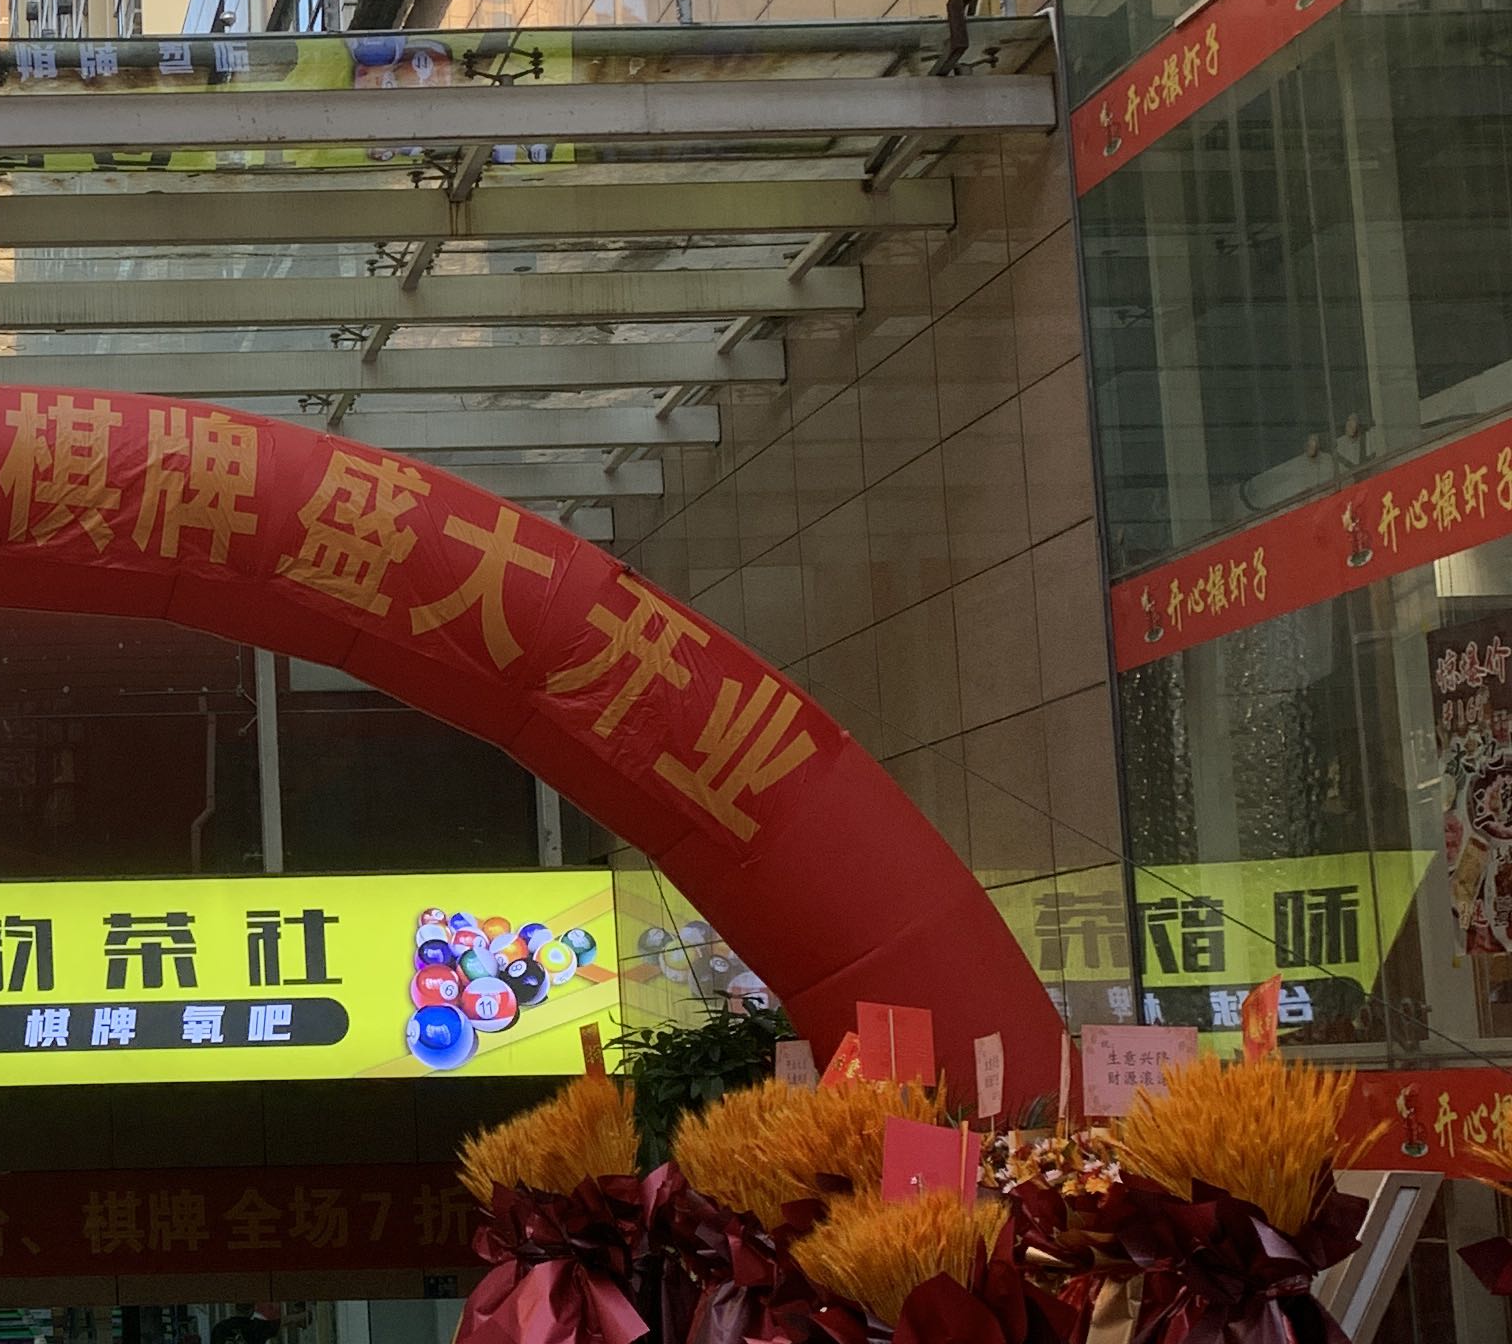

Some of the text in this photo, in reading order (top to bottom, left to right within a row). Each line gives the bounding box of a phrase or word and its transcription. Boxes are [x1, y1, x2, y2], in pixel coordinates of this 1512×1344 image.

[479, 1000, 495, 1016] 11
[25, 1008, 137, 1048] 棋牌
[182, 1003, 293, 1044] 氧吧
